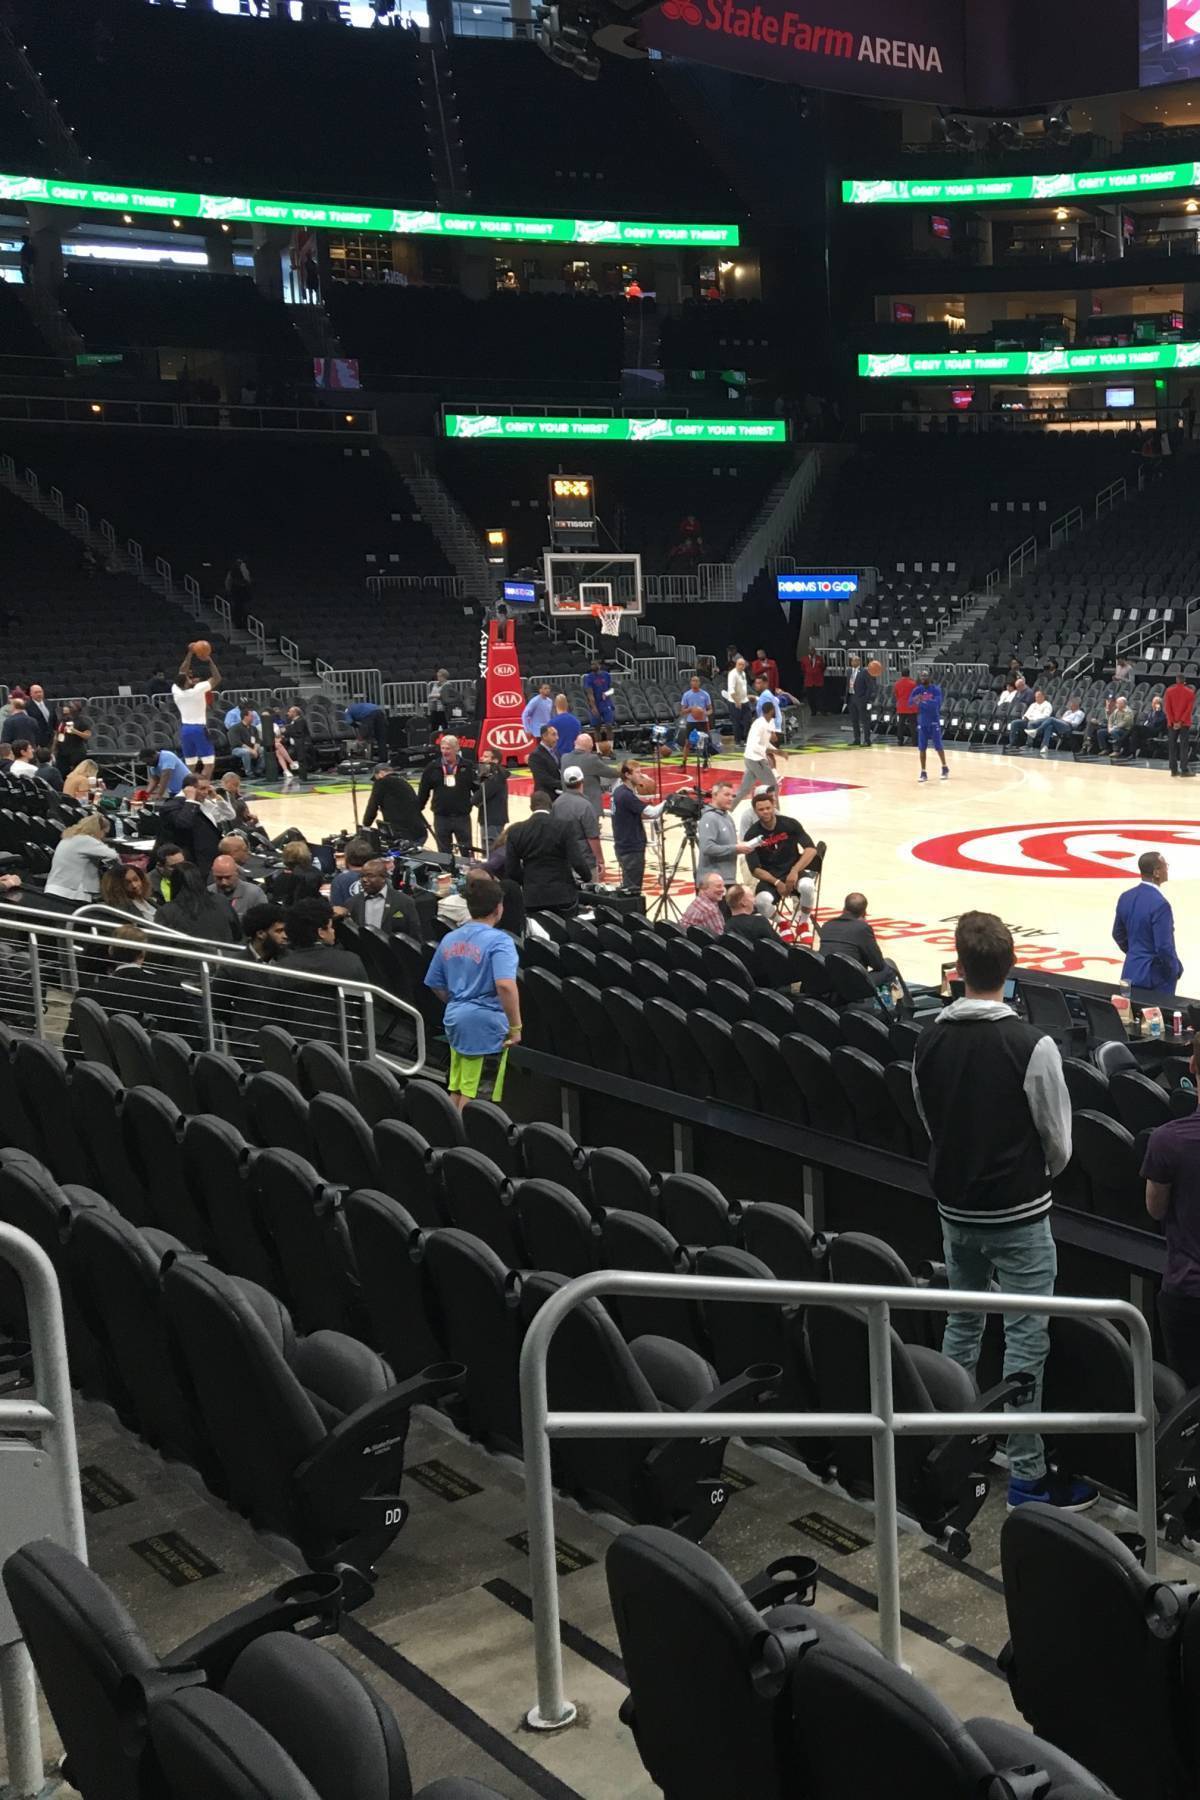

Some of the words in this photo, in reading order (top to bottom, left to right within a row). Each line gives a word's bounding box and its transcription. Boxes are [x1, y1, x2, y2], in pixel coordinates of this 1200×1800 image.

[857, 34, 943, 73] ARENA
[914, 360, 941, 370] OBEY
[944, 359, 972, 369] YOUR
[974, 358, 1009, 368] THIRST
[1070, 357, 1097, 368] OBEY
[1100, 355, 1127, 366] YOUR
[1128, 352, 1160, 363] THIRST
[506, 422, 535, 432] OBEY
[539, 423, 569, 432] YOUR
[572, 424, 608, 433] THIRST
[675, 425, 704, 434] OBEY
[707, 426, 736, 435] YOUR
[739, 426, 774, 435] THIRST
[778, 581, 816, 592] ROOMS
[818, 581, 830, 592] TO
[832, 581, 851, 592] GO
[479, 630, 489, 678] xfinity
[496, 666, 513, 675] KIA
[497, 694, 519, 705] KIA
[495, 730, 529, 745] KIA
[711, 1488, 724, 1504] CC
[975, 1483, 986, 1497] BB
[385, 1508, 402, 1525] DD
